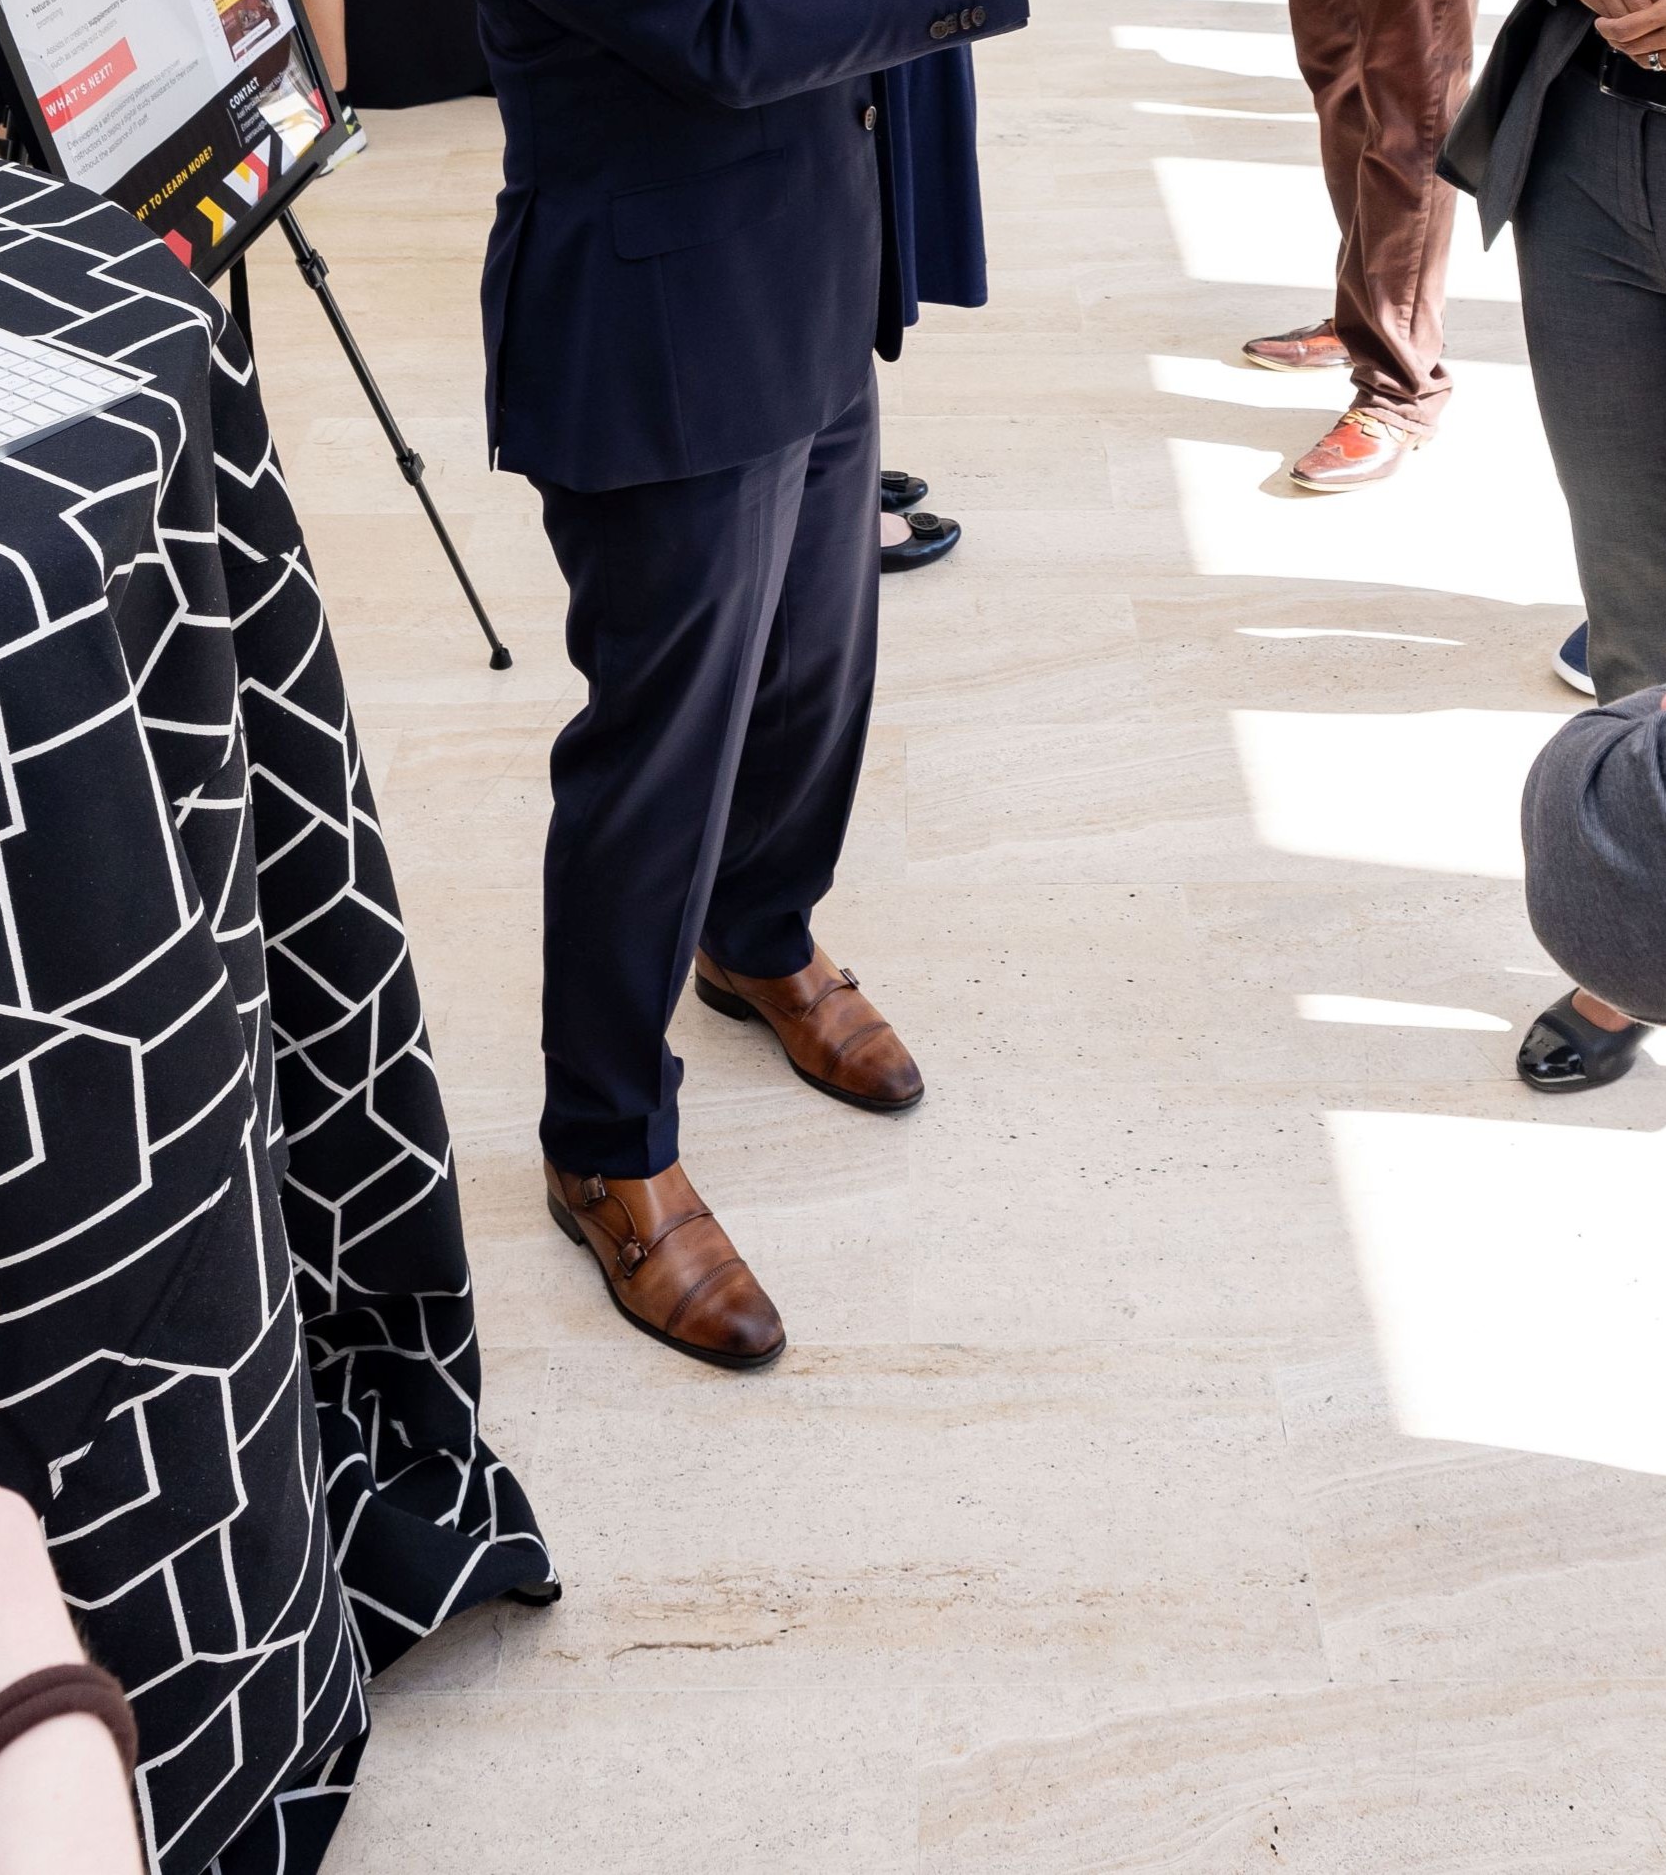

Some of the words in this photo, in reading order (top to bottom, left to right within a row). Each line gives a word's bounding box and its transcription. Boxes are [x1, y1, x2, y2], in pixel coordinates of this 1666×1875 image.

[45, 83, 87, 117] WHAT'S
[88, 62, 114, 89] NEXT?
[229, 77, 259, 109] CONTACT
[136, 203, 149, 222] NT
[149, 193, 163, 211] TO
[161, 169, 189, 197] LEARN
[187, 145, 214, 175] MORE?
